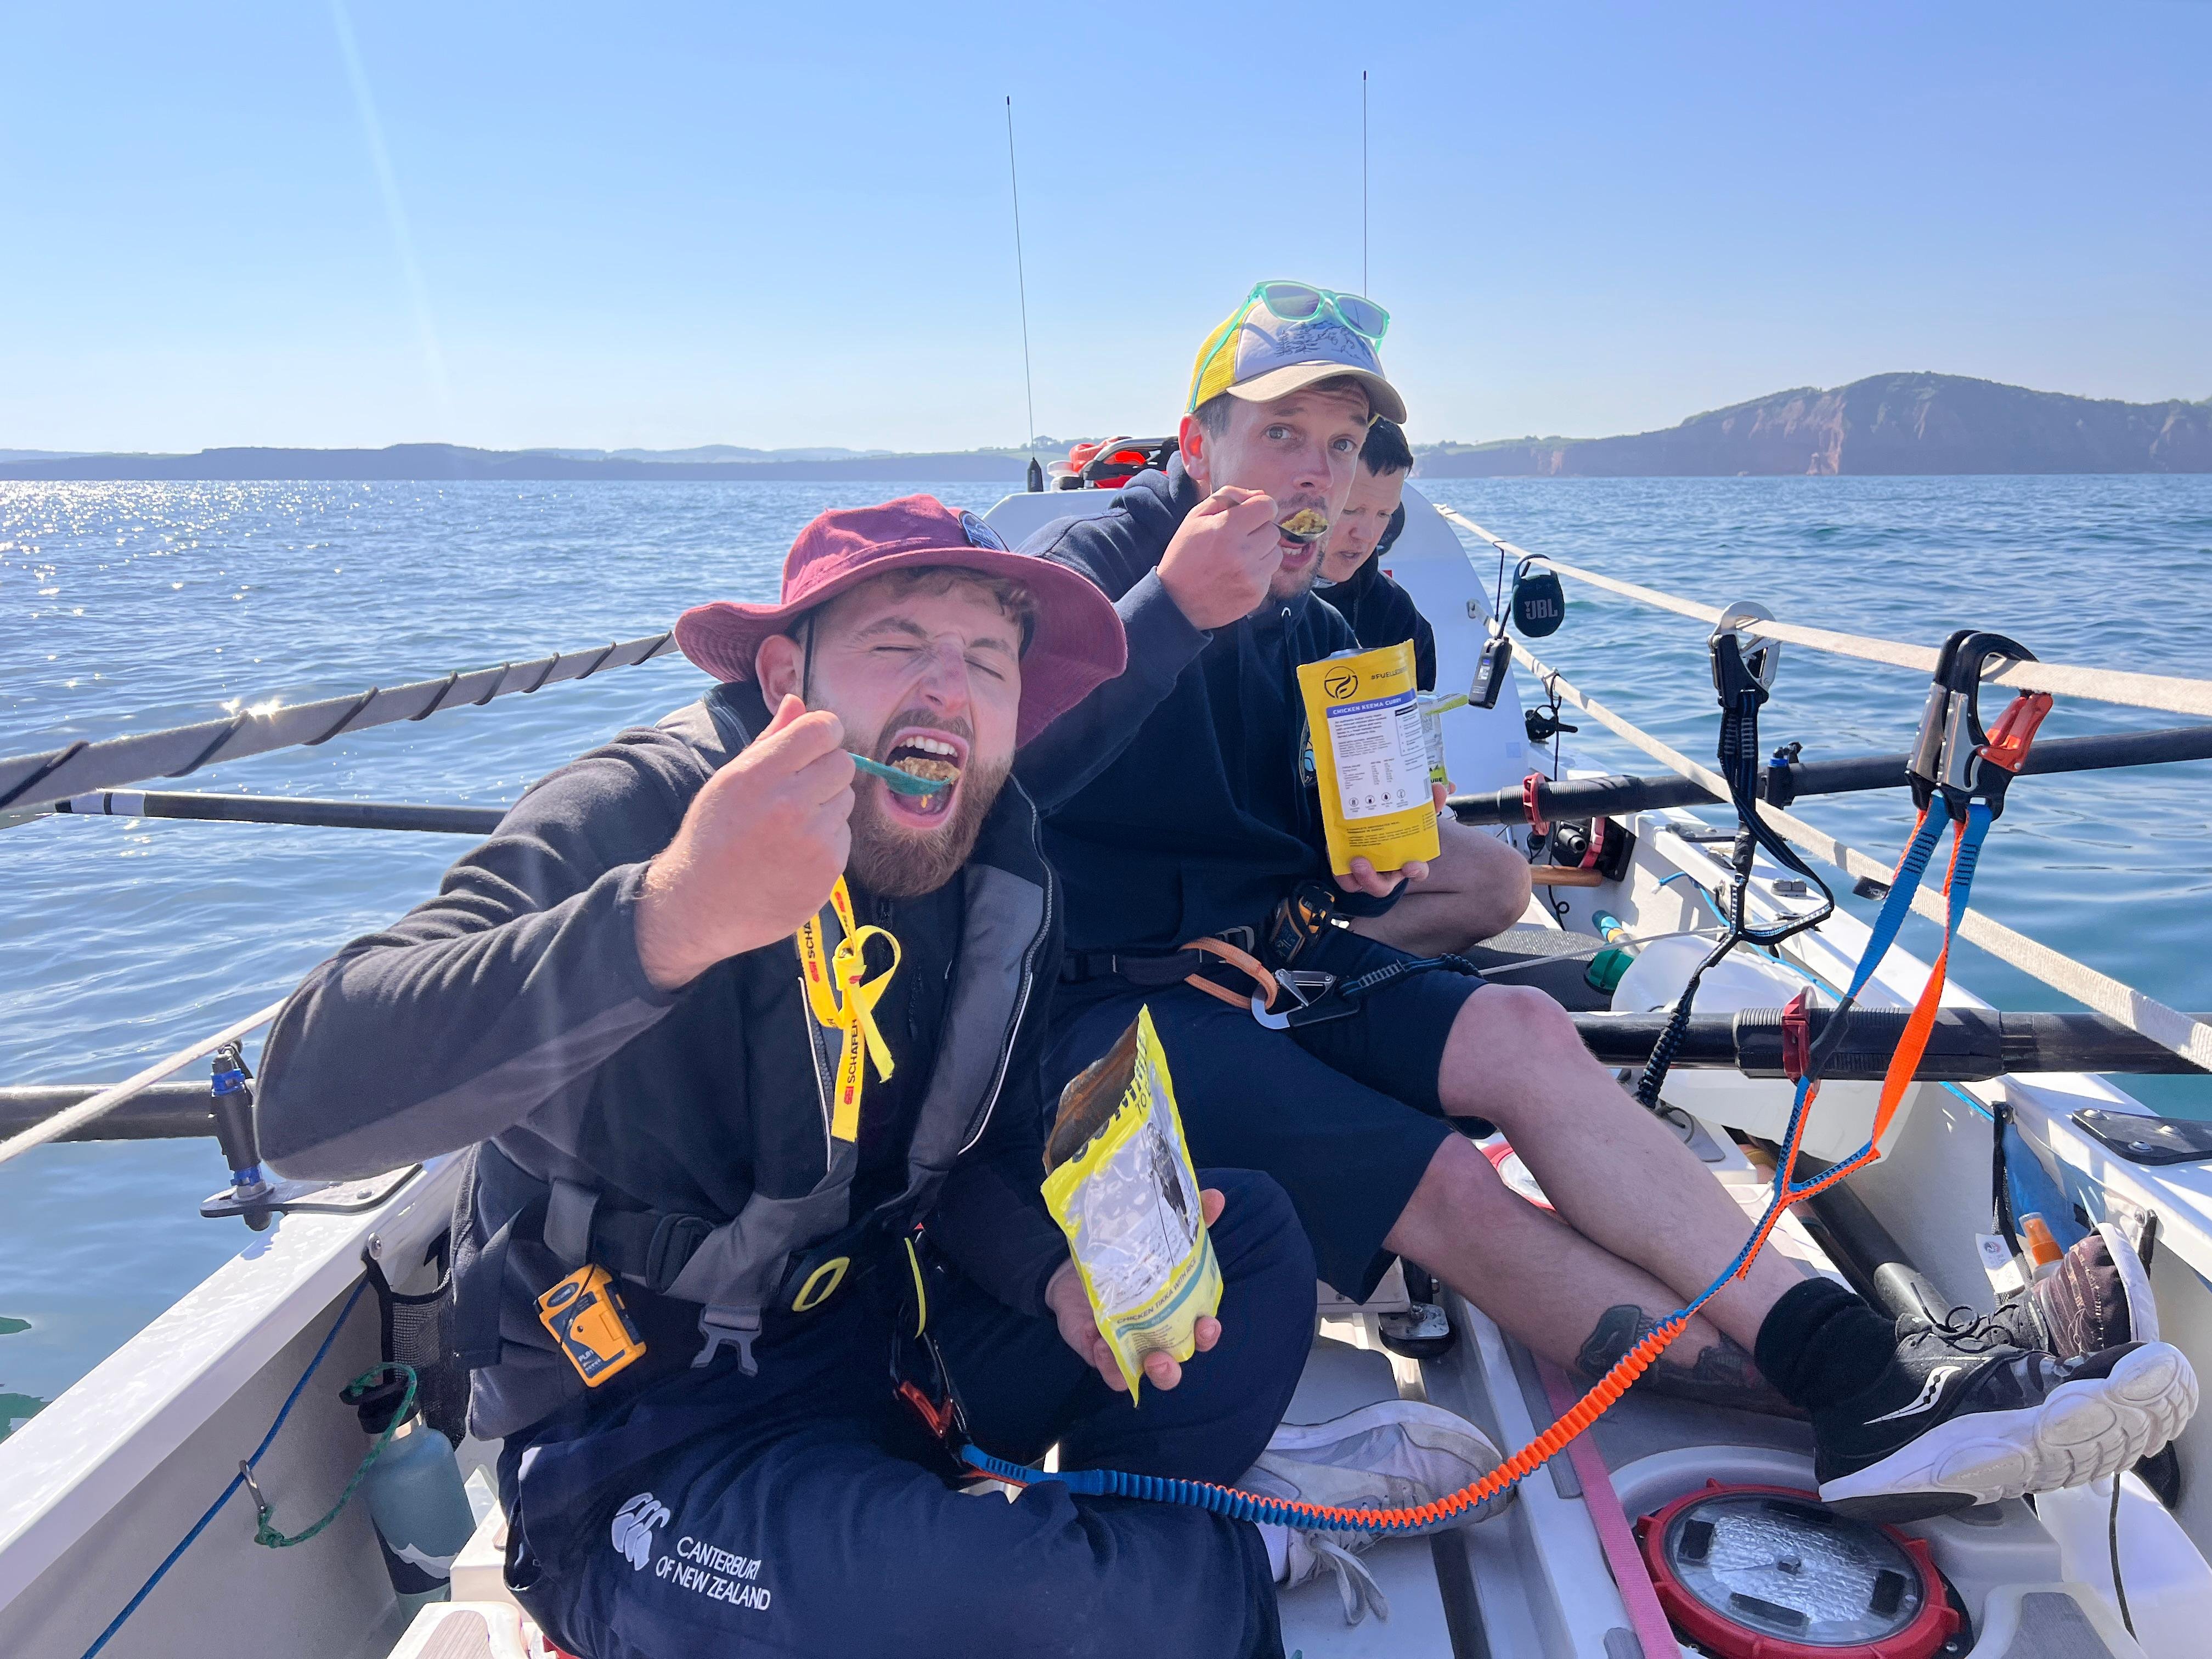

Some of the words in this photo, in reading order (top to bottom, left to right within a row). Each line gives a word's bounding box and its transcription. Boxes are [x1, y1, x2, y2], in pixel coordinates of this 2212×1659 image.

[1525, 599, 1558, 620] JBL
[1333, 706, 1360, 715] CHICKEN
[1361, 702, 1384, 710] KEEMA
[1385, 697, 1401, 706] CURRY
[1117, 1306, 1154, 1324] CHICKEN
[1155, 1290, 1173, 1308] TIKKA
[1173, 1273, 1187, 1291] WITH
[656, 1555, 675, 1579] OF
[672, 1562, 711, 1593] NEW
[707, 1576, 771, 1611] ZEALAND
